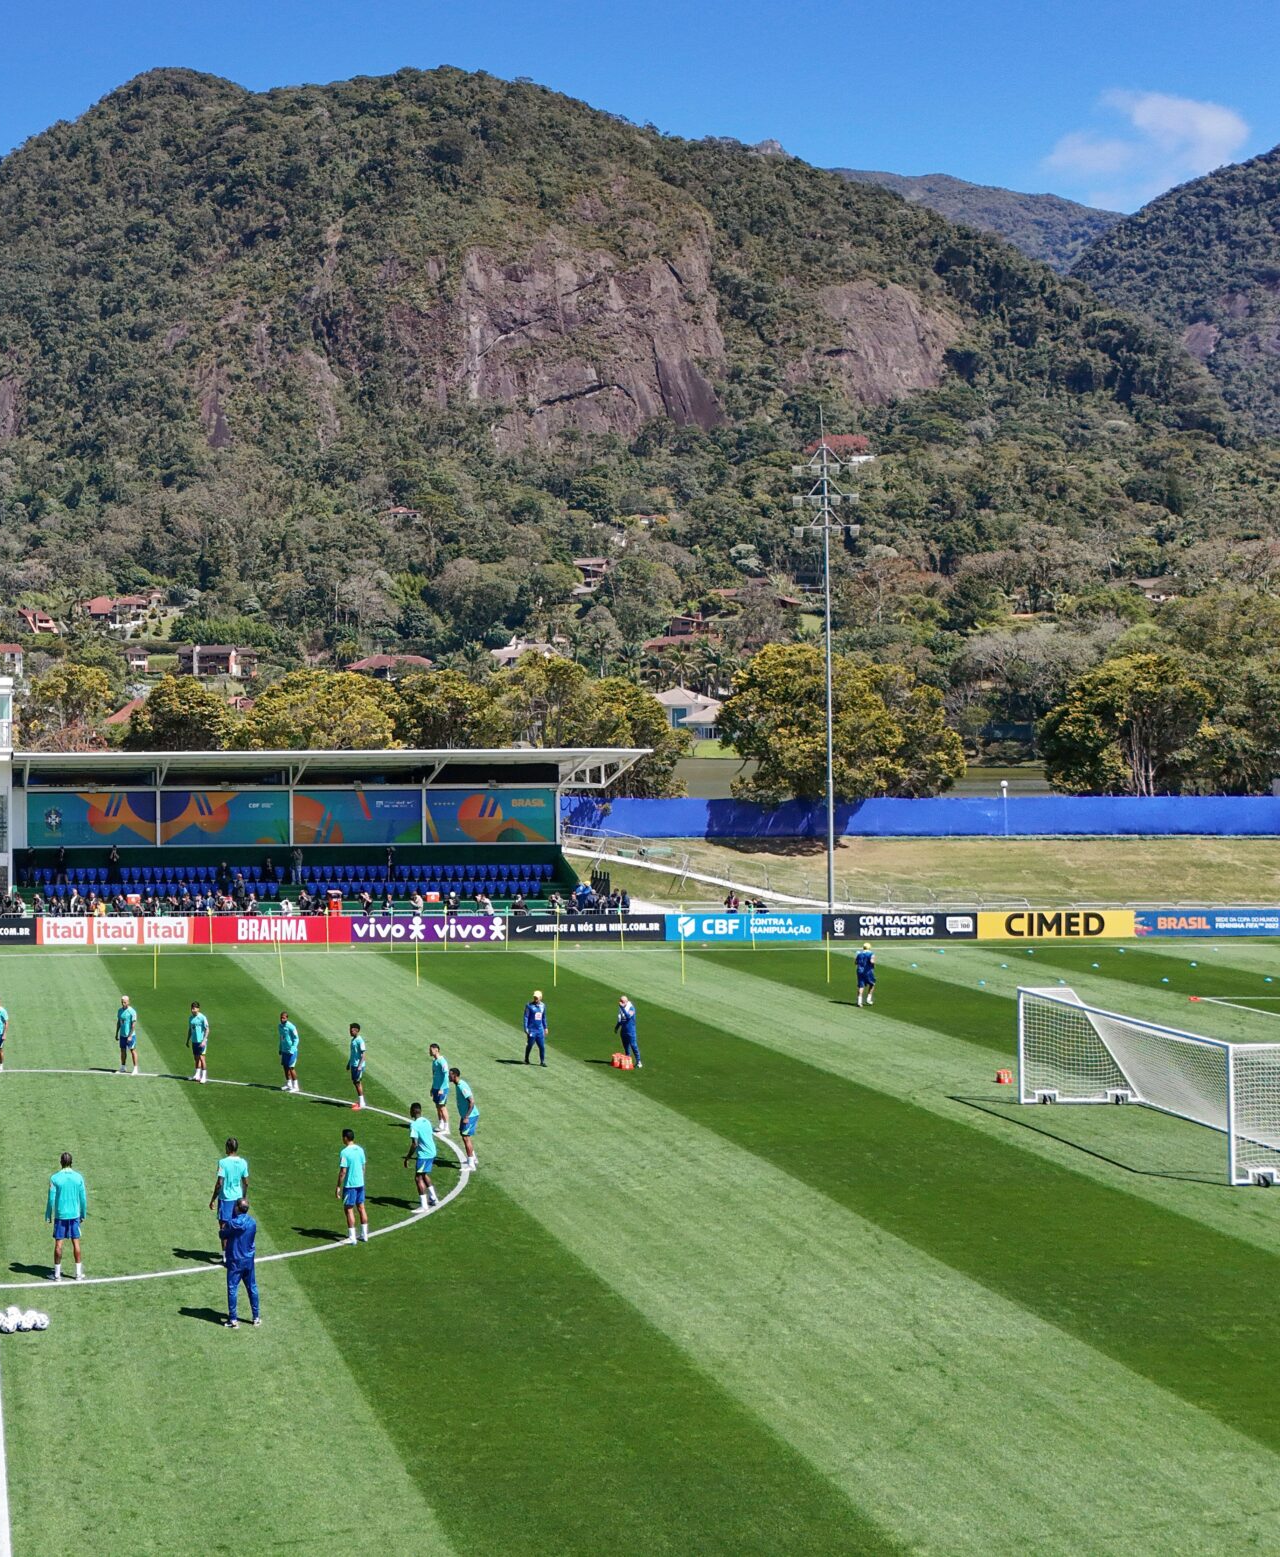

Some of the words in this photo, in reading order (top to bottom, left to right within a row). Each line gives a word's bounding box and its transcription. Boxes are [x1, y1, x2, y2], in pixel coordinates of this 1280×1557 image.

[511, 798, 545, 807] BRASIL
[750, 917, 784, 925] CONTRA
[859, 915, 884, 926] COM
[885, 915, 934, 925] RACISMO
[1005, 912, 1105, 936] CIMED
[1157, 917, 1211, 929] BRASIL
[46, 921, 84, 939] itaú
[96, 920, 134, 938] itaú
[147, 920, 184, 938] itaú
[237, 918, 307, 941] BRAHMA
[353, 917, 406, 938] vivo
[433, 918, 486, 939] vivo
[569, 924, 576, 932] A
[577, 922, 593, 932] NÓS
[595, 923, 607, 932] EM
[609, 923, 660, 931] NIKE.COM.BR
[702, 919, 740, 935] CBF
[750, 925, 811, 936] MANIPULAÇÃO
[860, 925, 882, 936] NÃO
[883, 927, 905, 936] TEM
[907, 926, 934, 936] JOGO
